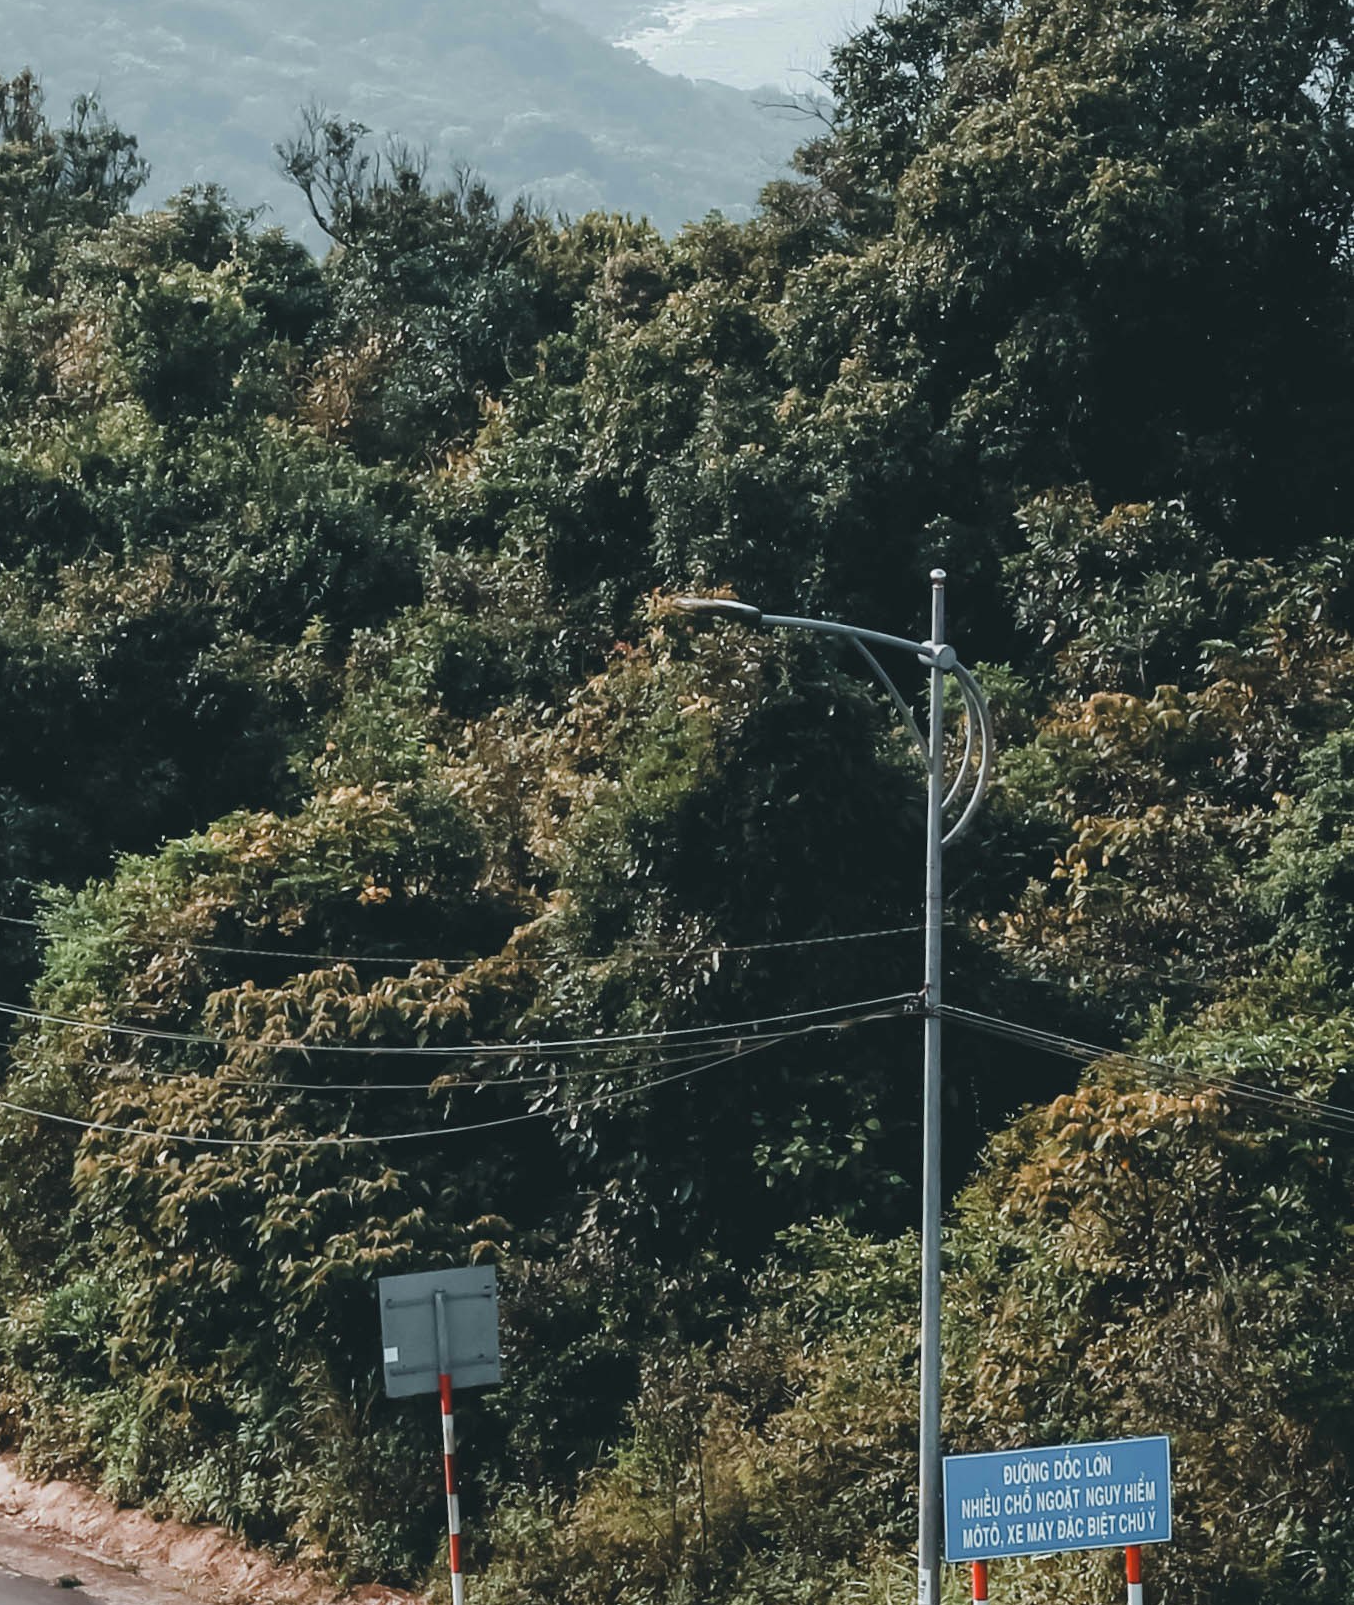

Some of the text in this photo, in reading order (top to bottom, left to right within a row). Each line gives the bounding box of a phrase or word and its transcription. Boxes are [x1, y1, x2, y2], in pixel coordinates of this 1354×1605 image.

[961, 1487, 1000, 1519] NHIỀU
[1036, 1485, 1080, 1513] NGOẶT
[1086, 1484, 1121, 1507] NGUY
[1124, 1471, 1156, 1503] HIỂM
[1007, 1523, 1023, 1545] XE
[1026, 1517, 1054, 1542] MÁY
[1057, 1514, 1084, 1542] ĐẶC
[1087, 1511, 1116, 1539] BIỆT
[1118, 1506, 1145, 1534] CHÚ
[1148, 1505, 1156, 1531] Ý
